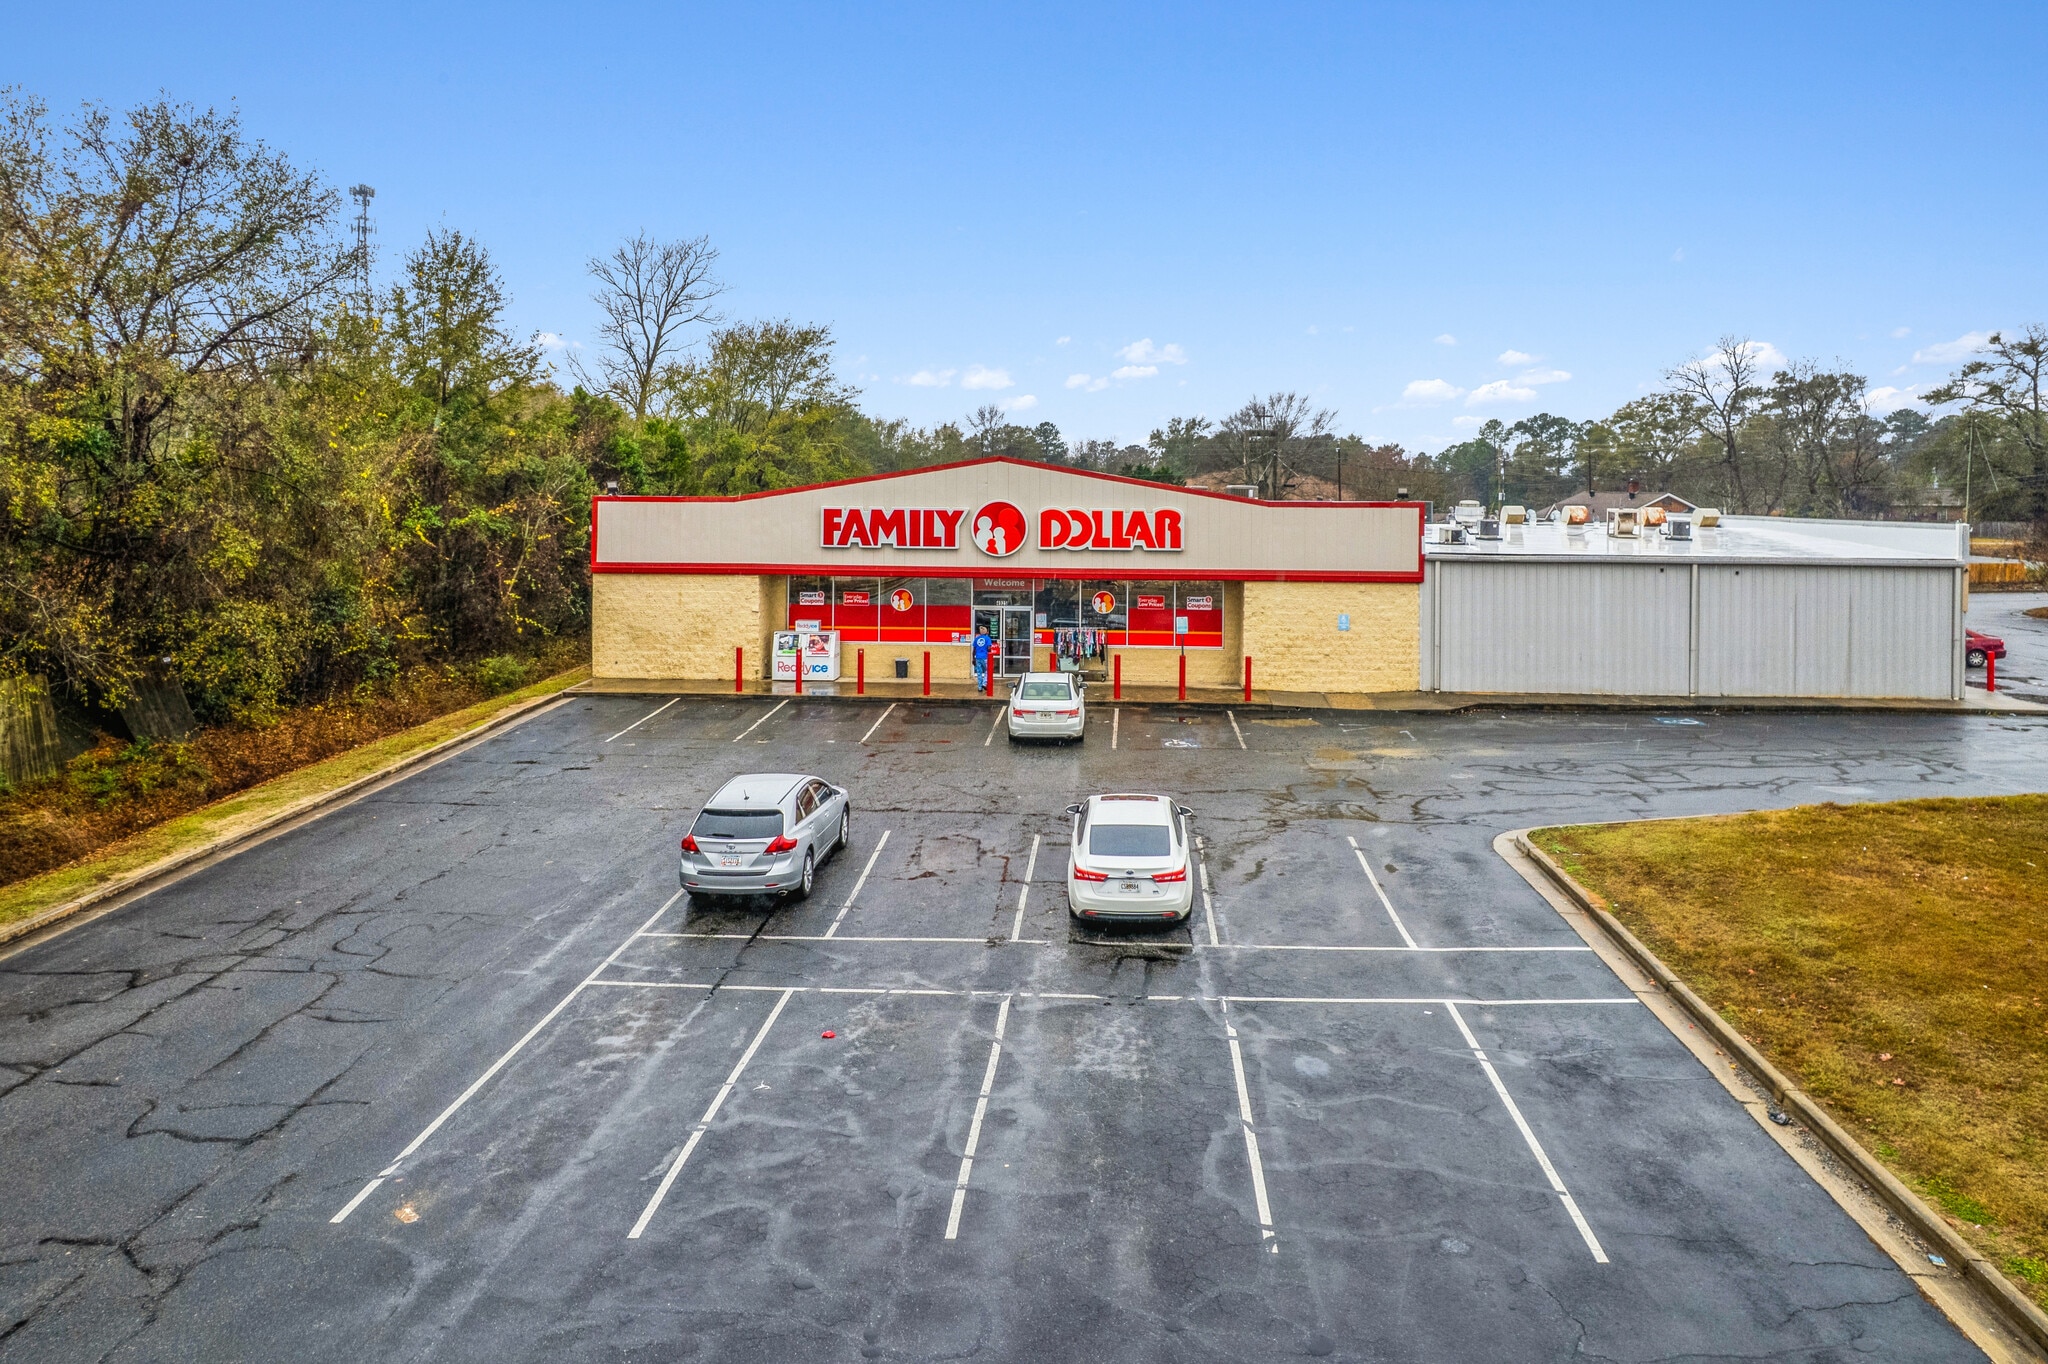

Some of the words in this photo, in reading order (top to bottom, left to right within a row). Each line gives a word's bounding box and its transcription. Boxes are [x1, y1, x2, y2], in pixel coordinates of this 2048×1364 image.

[823, 508, 965, 547] FAMILY
[1040, 509, 1182, 549] DOLLAR
[983, 578, 1025, 587] Welcome
